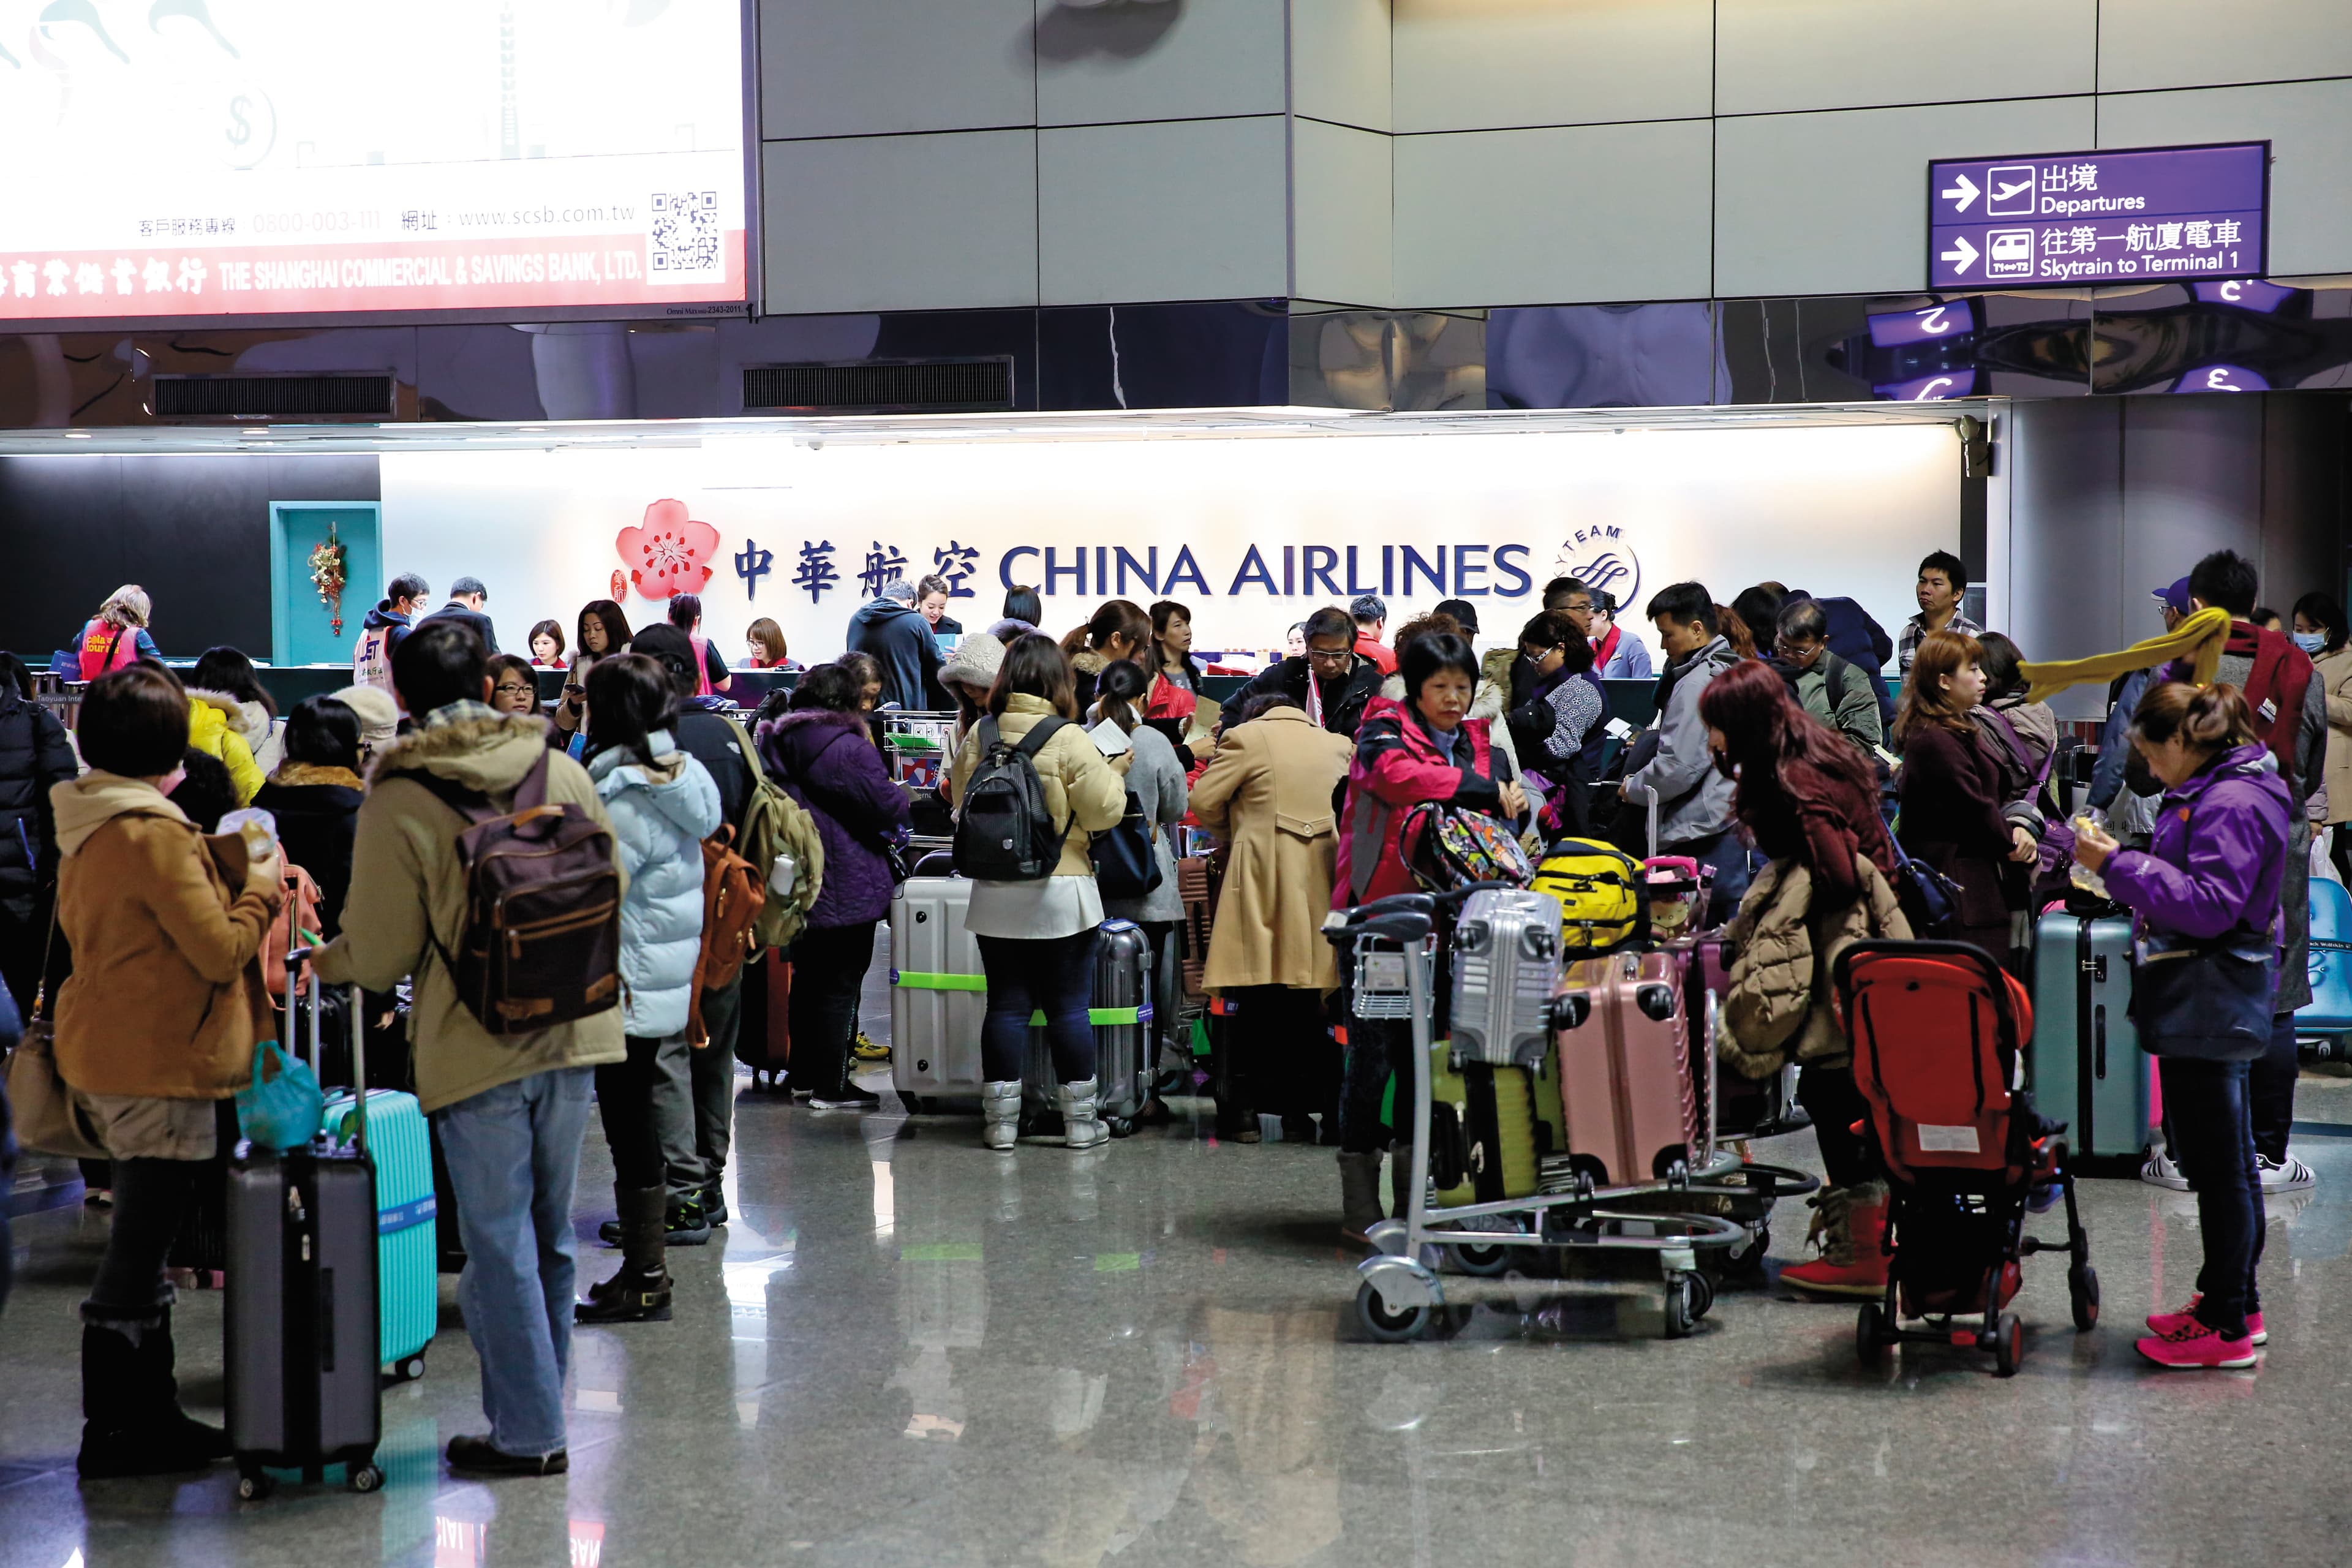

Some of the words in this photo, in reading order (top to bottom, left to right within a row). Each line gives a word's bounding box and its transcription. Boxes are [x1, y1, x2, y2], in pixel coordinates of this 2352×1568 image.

[2041, 164, 2098, 192] 出境
[459, 204, 635, 226] www.scsb.com.tw
[2041, 195, 2145, 217] Departures
[2040, 219, 2242, 255] 往第一航廈電車
[0, 257, 207, 298] 商業儲蓄銀行
[219, 262, 251, 291] THE
[254, 260, 337, 290] SHANGHAI
[342, 257, 451, 288] COMMERCIAL
[455, 256, 468, 282] &
[471, 253, 545, 284] SAVINGS
[549, 252, 600, 285] BANK,
[605, 251, 642, 281] LTD.
[1993, 263, 2003, 272] T1
[2017, 263, 2029, 271] T2
[2040, 257, 2112, 280] Skytrain
[2117, 260, 2138, 273] to
[2142, 252, 2223, 272] Terminal
[2230, 252, 2238, 268] 1
[734, 538, 980, 604] 中華航空
[999, 544, 1212, 597] CHINA
[1227, 543, 1532, 598] AIRLINES
